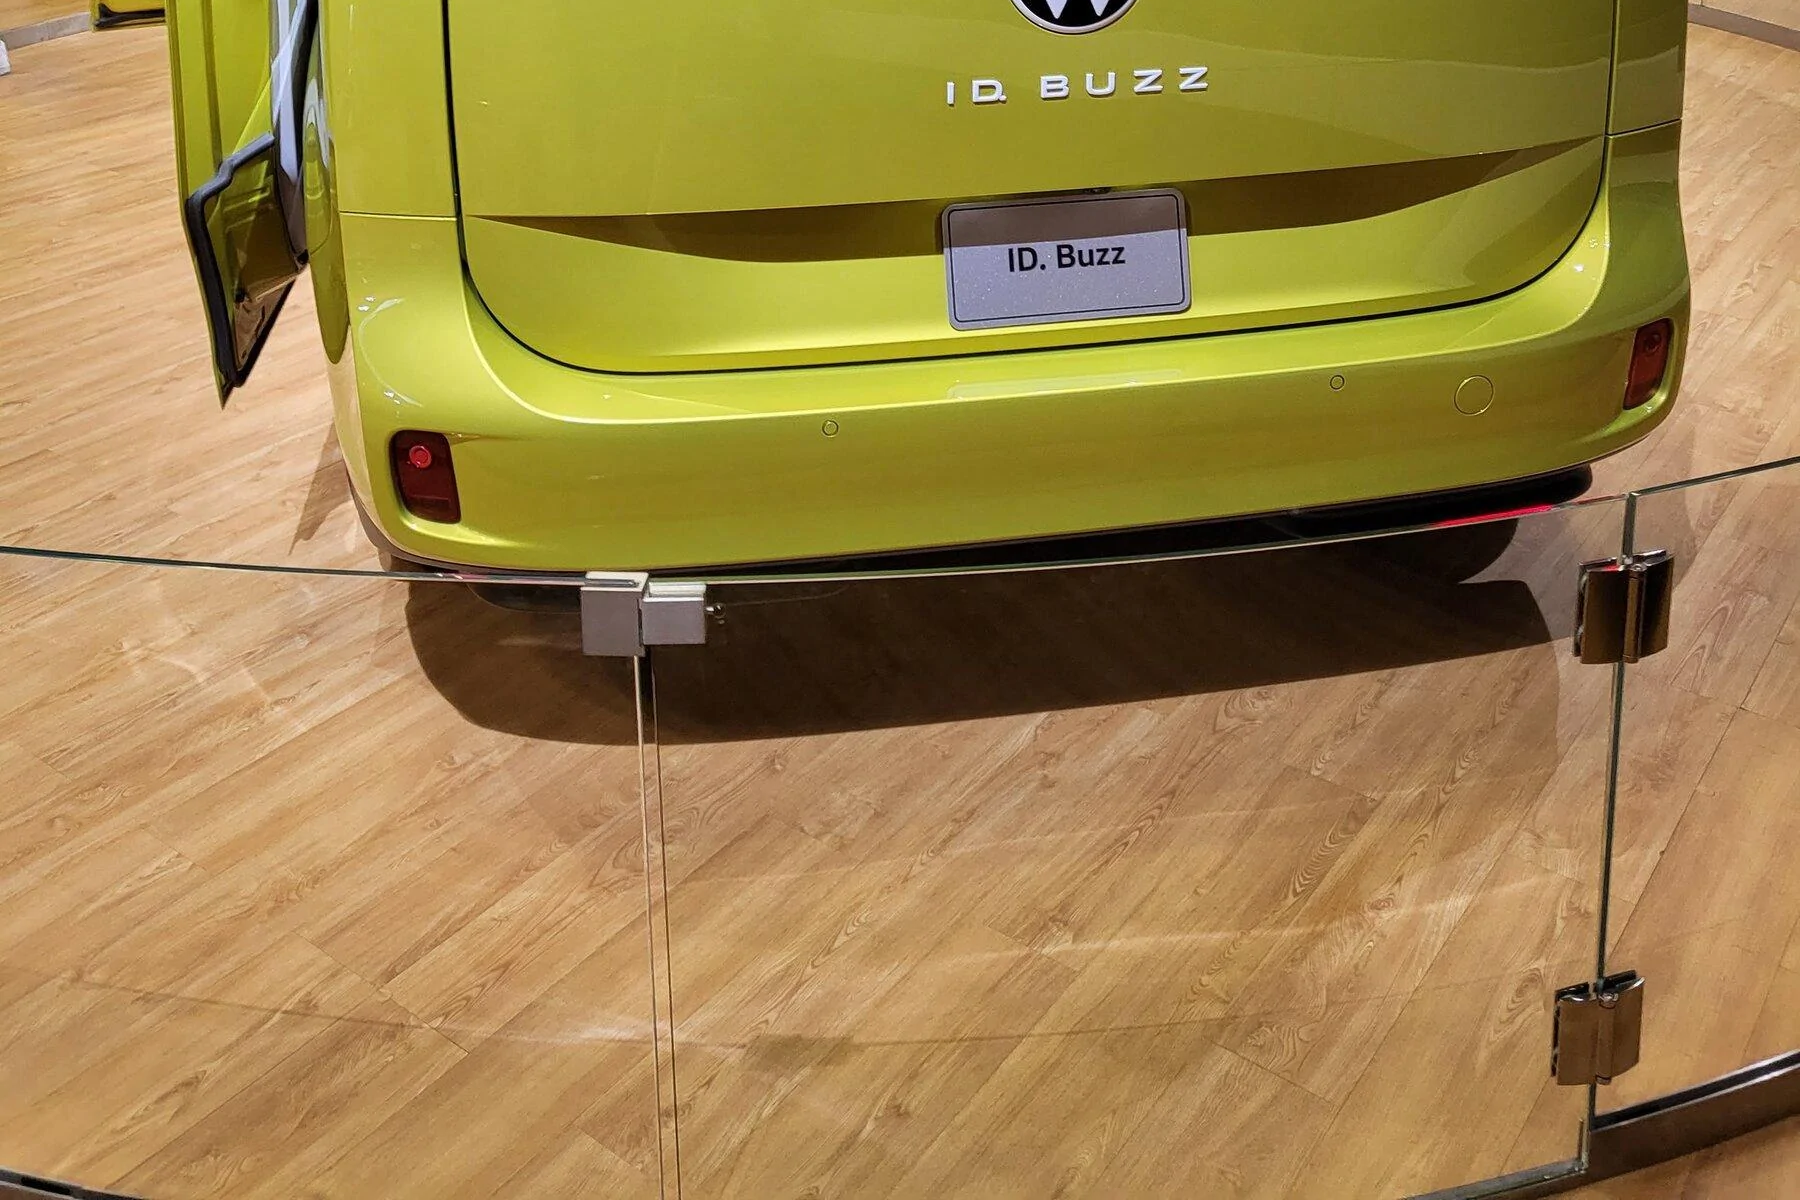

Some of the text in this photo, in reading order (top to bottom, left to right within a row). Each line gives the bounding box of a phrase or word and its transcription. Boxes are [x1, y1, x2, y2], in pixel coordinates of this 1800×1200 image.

[1040, 66, 1209, 100] BUZZ
[1007, 243, 1126, 272] ID. Buzz
